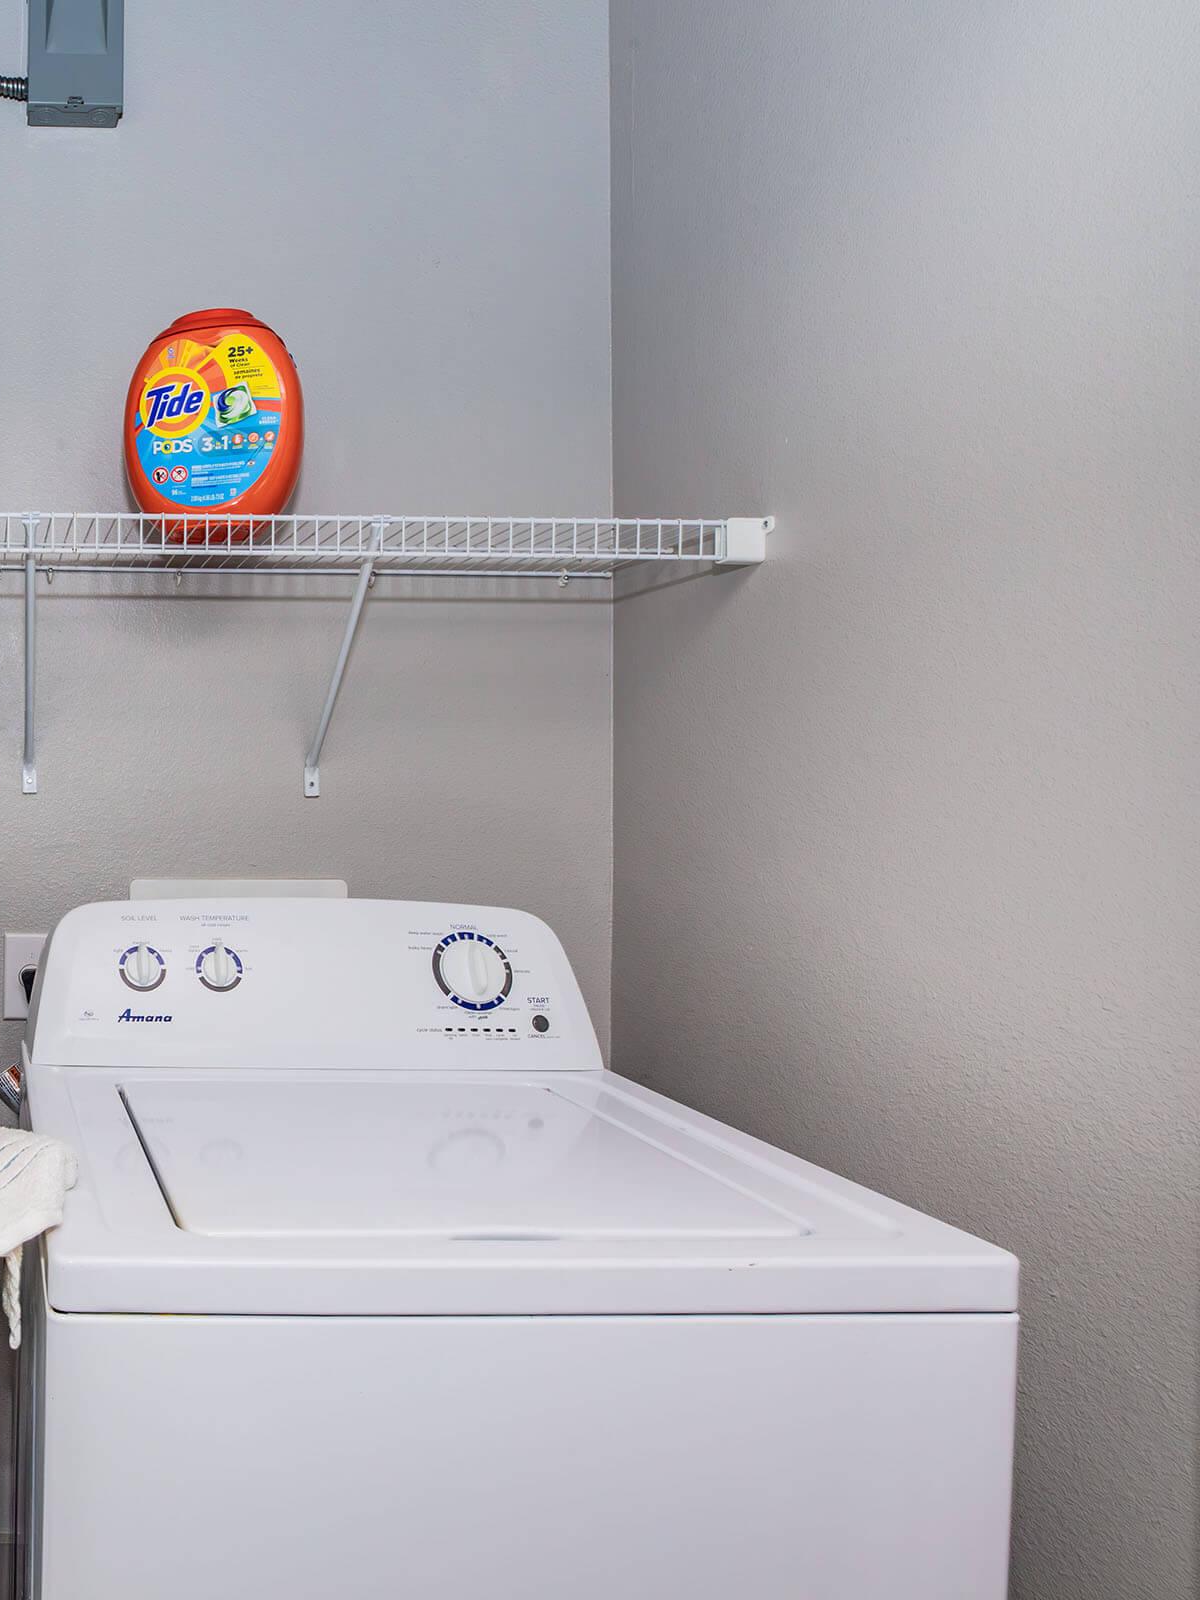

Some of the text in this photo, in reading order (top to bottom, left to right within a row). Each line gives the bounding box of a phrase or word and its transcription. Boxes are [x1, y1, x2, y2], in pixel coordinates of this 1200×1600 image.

[228, 346, 253, 357] 25+
[146, 383, 204, 428] Tide
[153, 439, 193, 455] PODS
[118, 1009, 173, 1022] Amana
